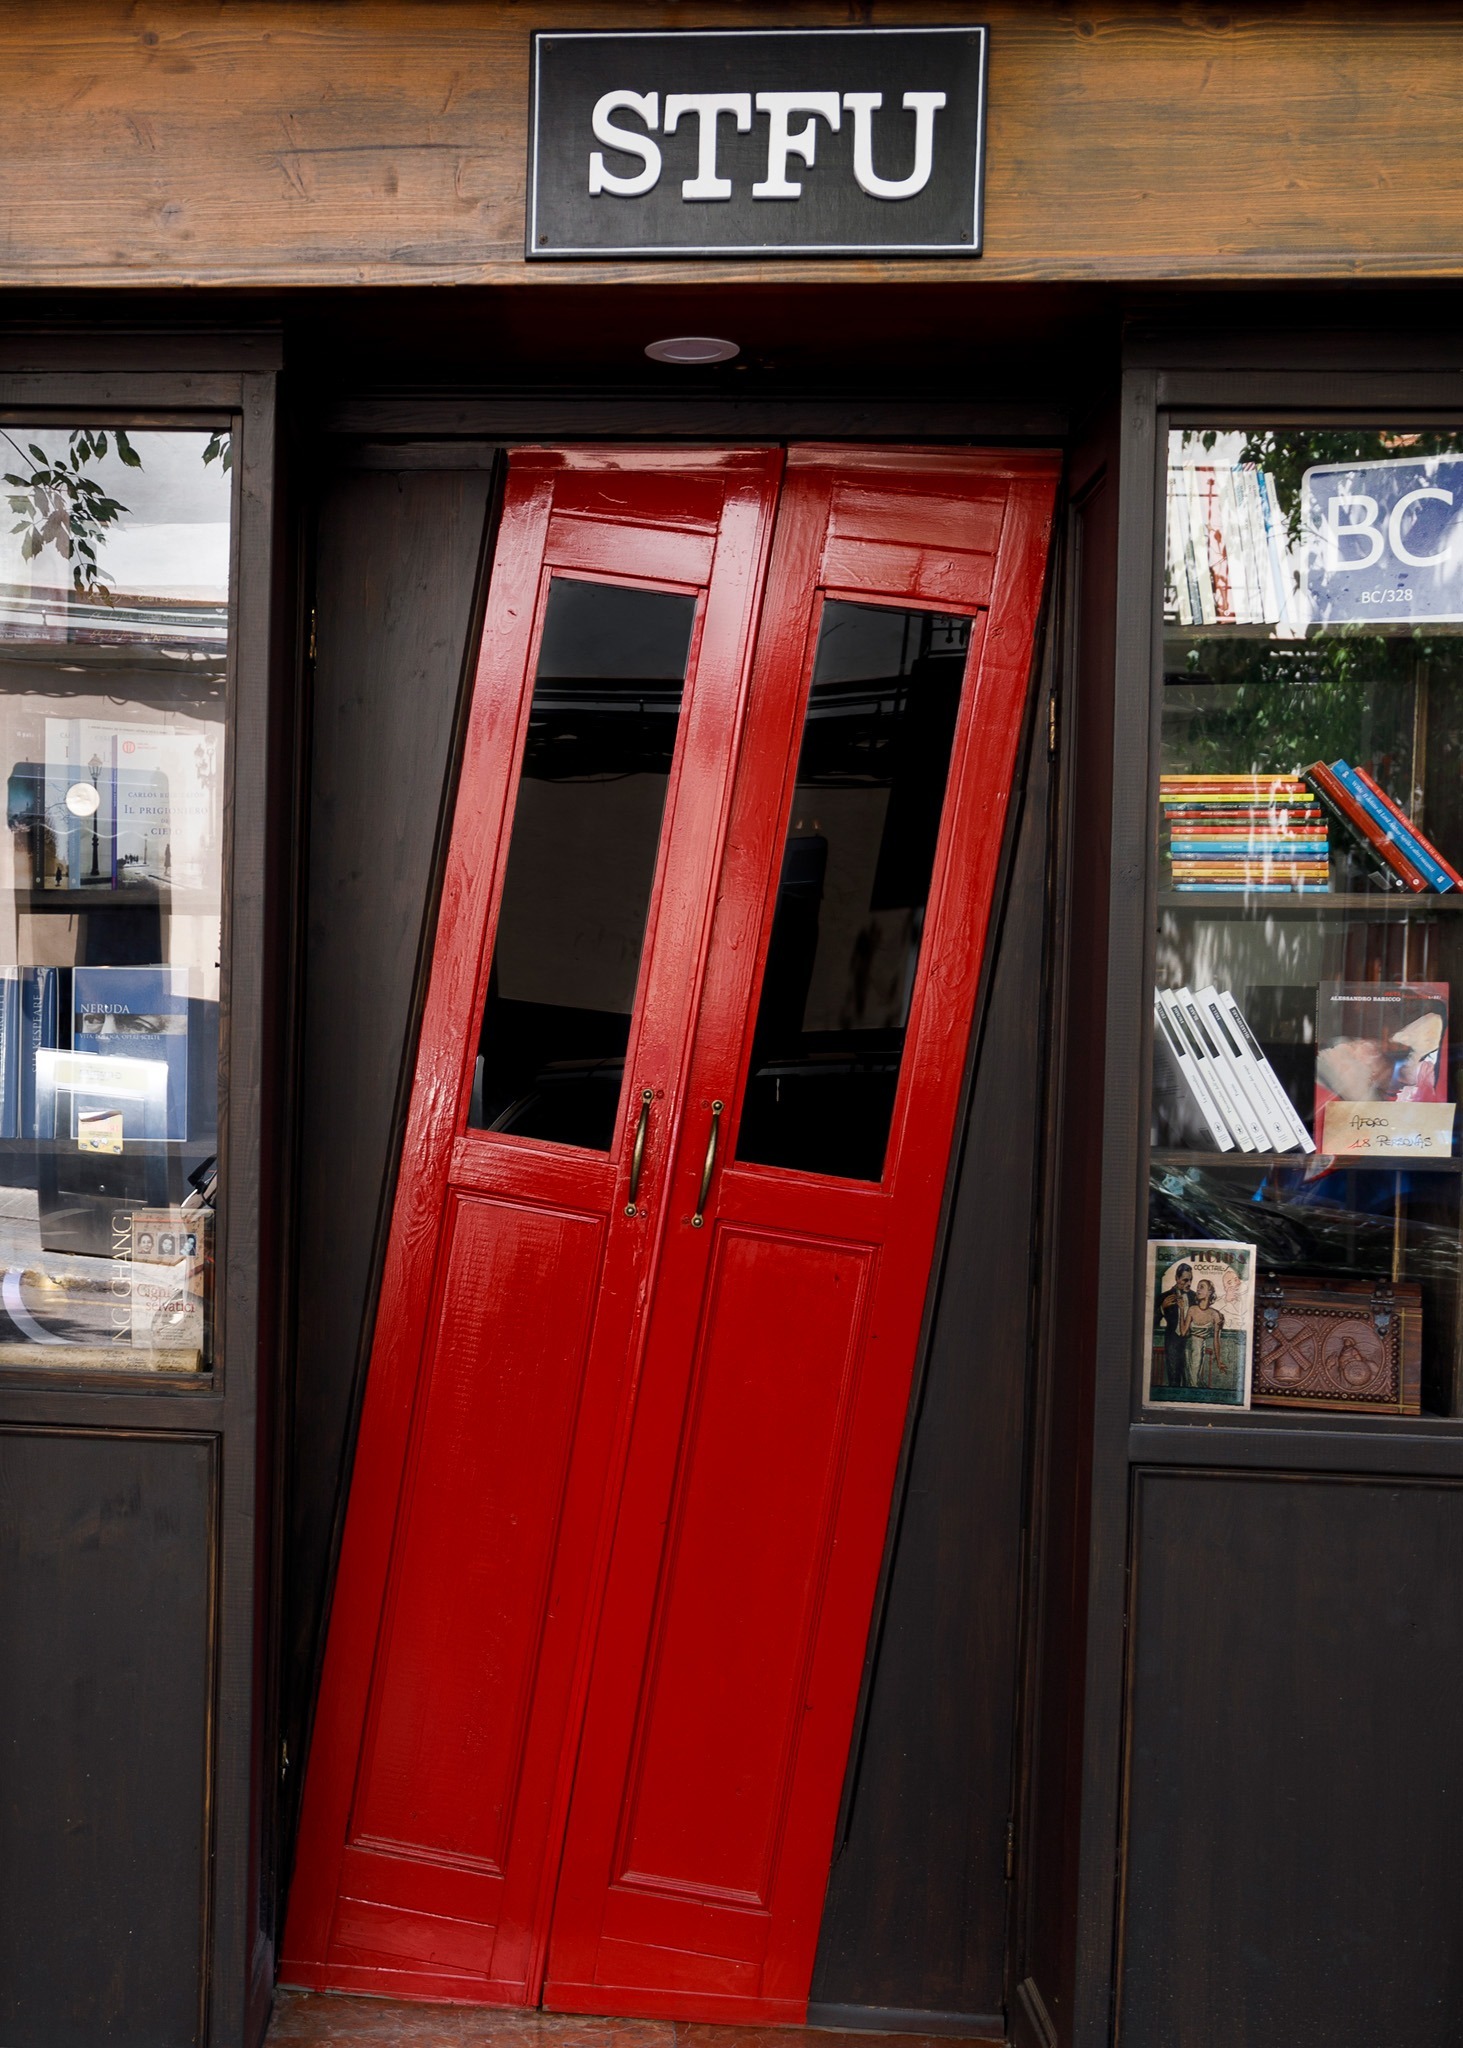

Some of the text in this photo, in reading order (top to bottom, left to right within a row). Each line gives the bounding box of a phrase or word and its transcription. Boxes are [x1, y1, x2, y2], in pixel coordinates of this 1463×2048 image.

[589, 89, 947, 202] STFU
[1326, 488, 1454, 572] BC
[1361, 589, 1414, 604] BC/328
[128, 791, 158, 799] CARLOS
[80, 1003, 130, 1014] NERUDA
[112, 1216, 133, 1298] CHANG
[137, 1283, 171, 1301] Cigni
[145, 1301, 196, 1313] selvatici
